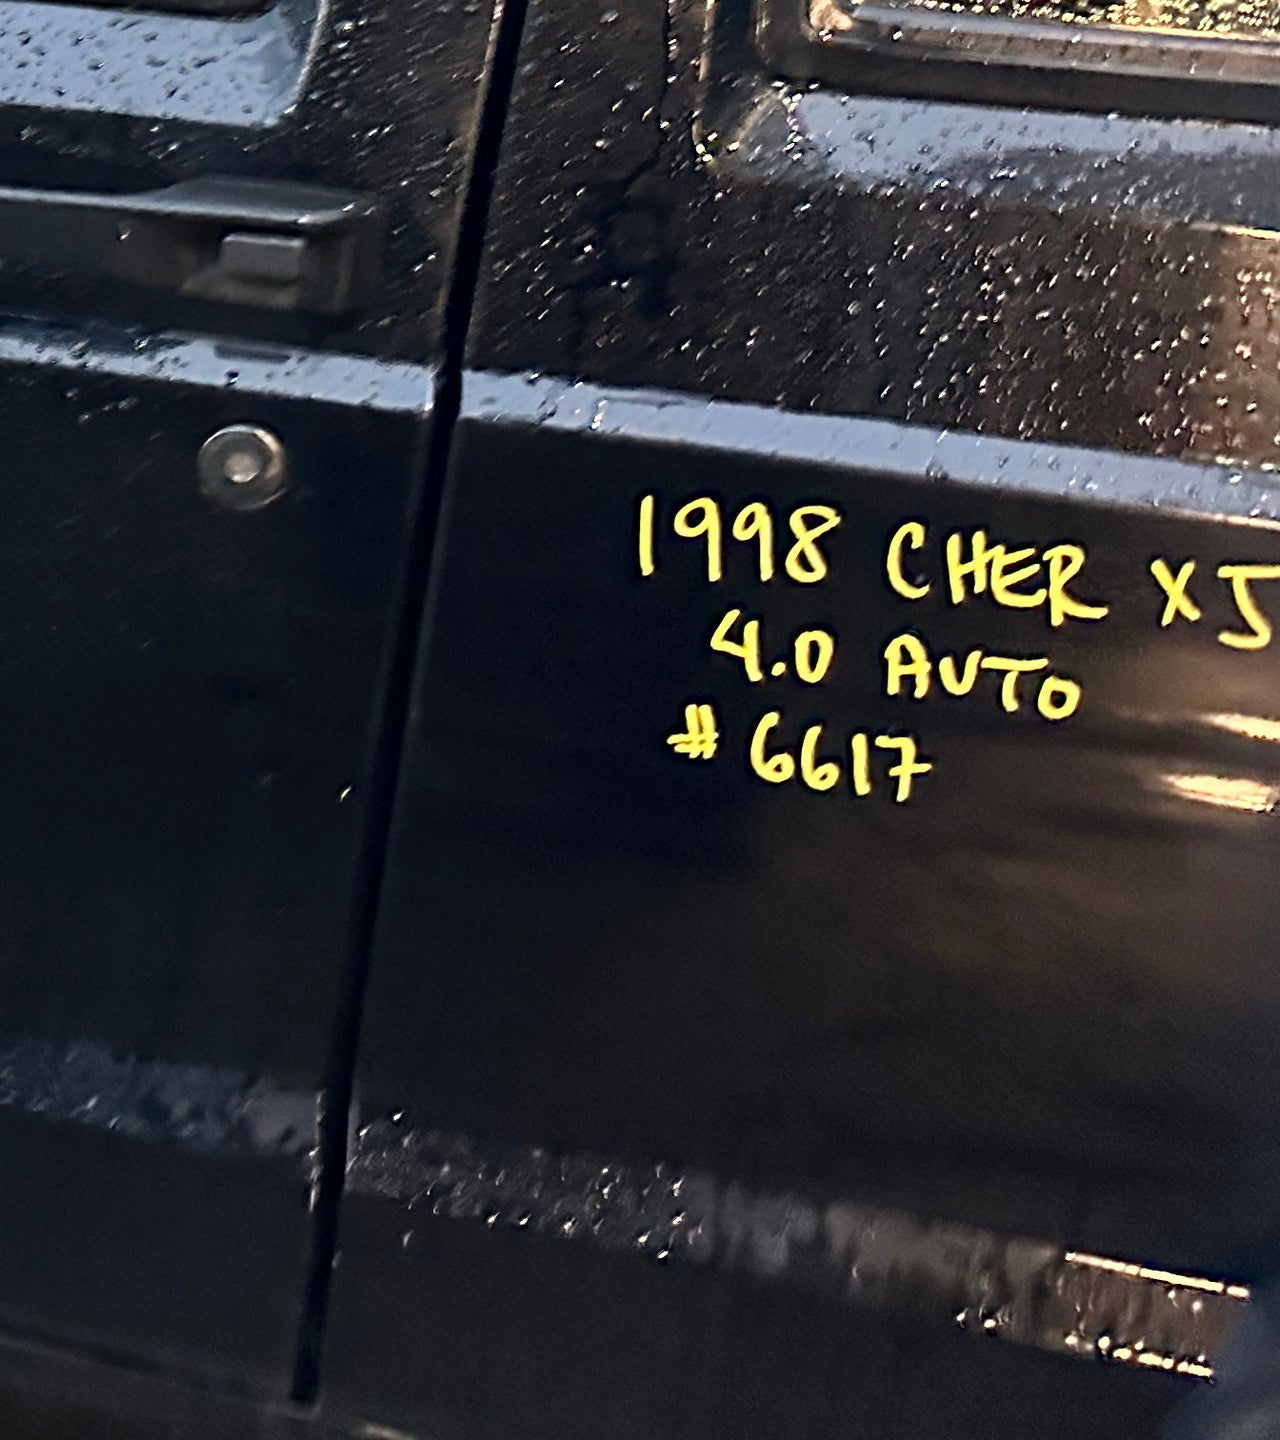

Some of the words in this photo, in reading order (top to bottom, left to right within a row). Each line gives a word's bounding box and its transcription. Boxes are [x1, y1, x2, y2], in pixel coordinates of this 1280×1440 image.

[636, 493, 843, 585] 1998
[884, 519, 1110, 629] CHER
[709, 607, 836, 686] 4.0
[882, 632, 1083, 722] AUTO
